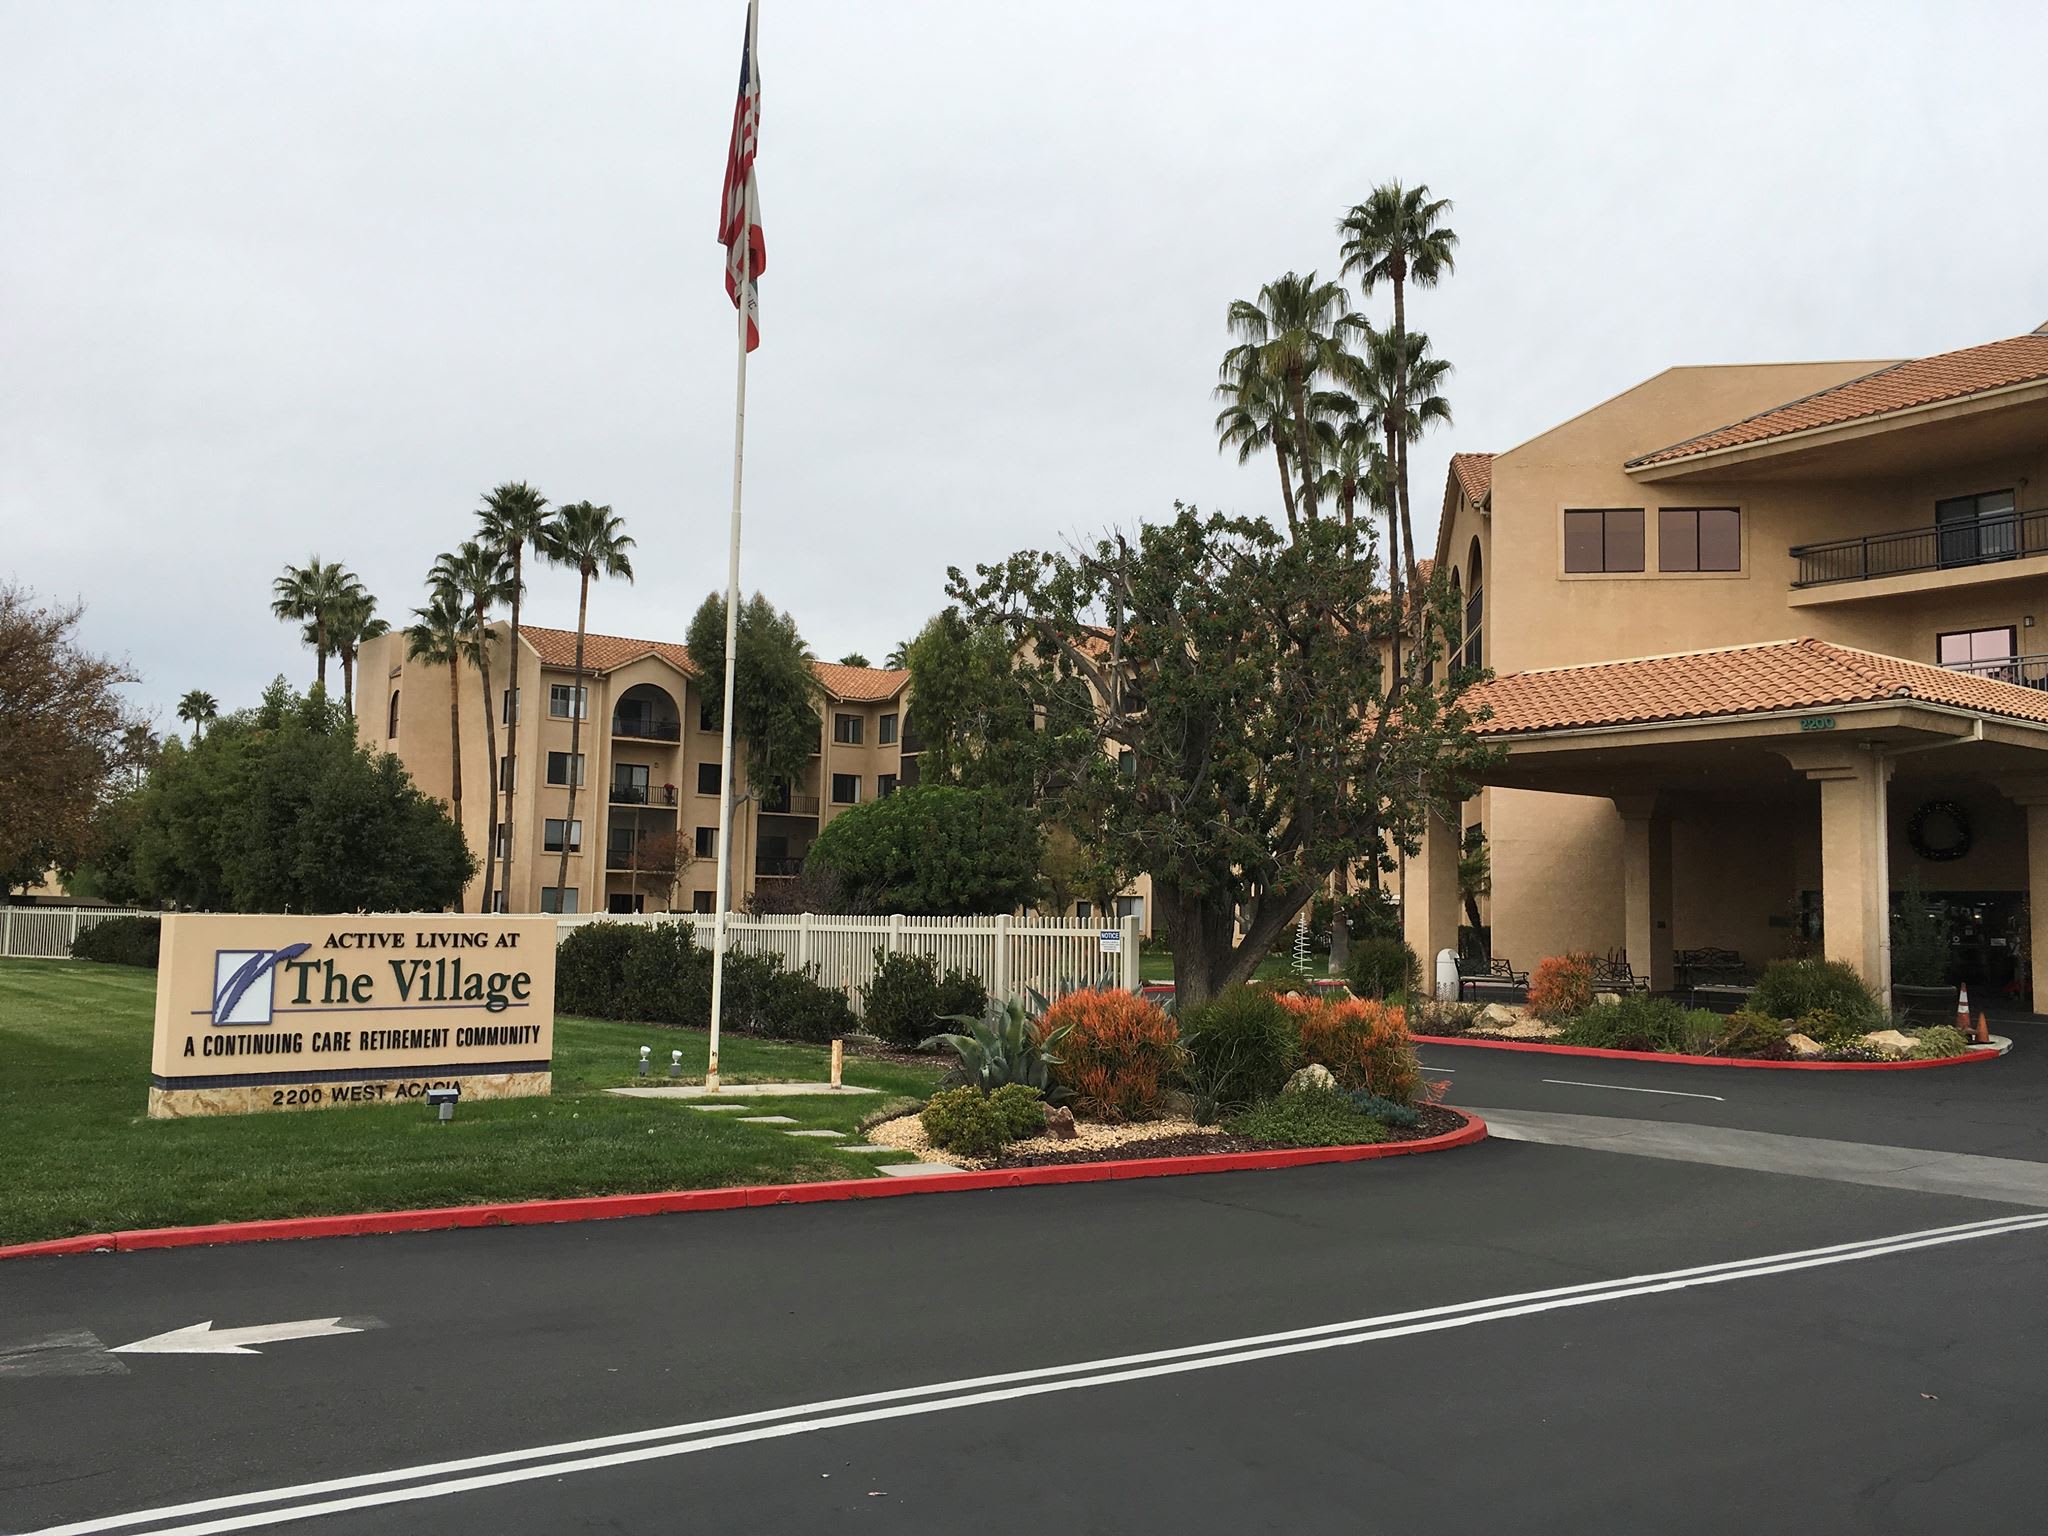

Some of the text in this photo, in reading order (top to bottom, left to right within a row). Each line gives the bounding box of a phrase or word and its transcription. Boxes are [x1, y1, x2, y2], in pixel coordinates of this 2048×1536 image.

[1801, 717, 1835, 730] 2200
[323, 932, 520, 949] ACTIVE LIVING AT
[284, 957, 531, 1013] The Village
[184, 1025, 541, 1057] A CONTINUING CARE RETIREMENT COMMUNITY
[272, 1088, 322, 1106] 2200
[331, 1084, 386, 1102] WEST
